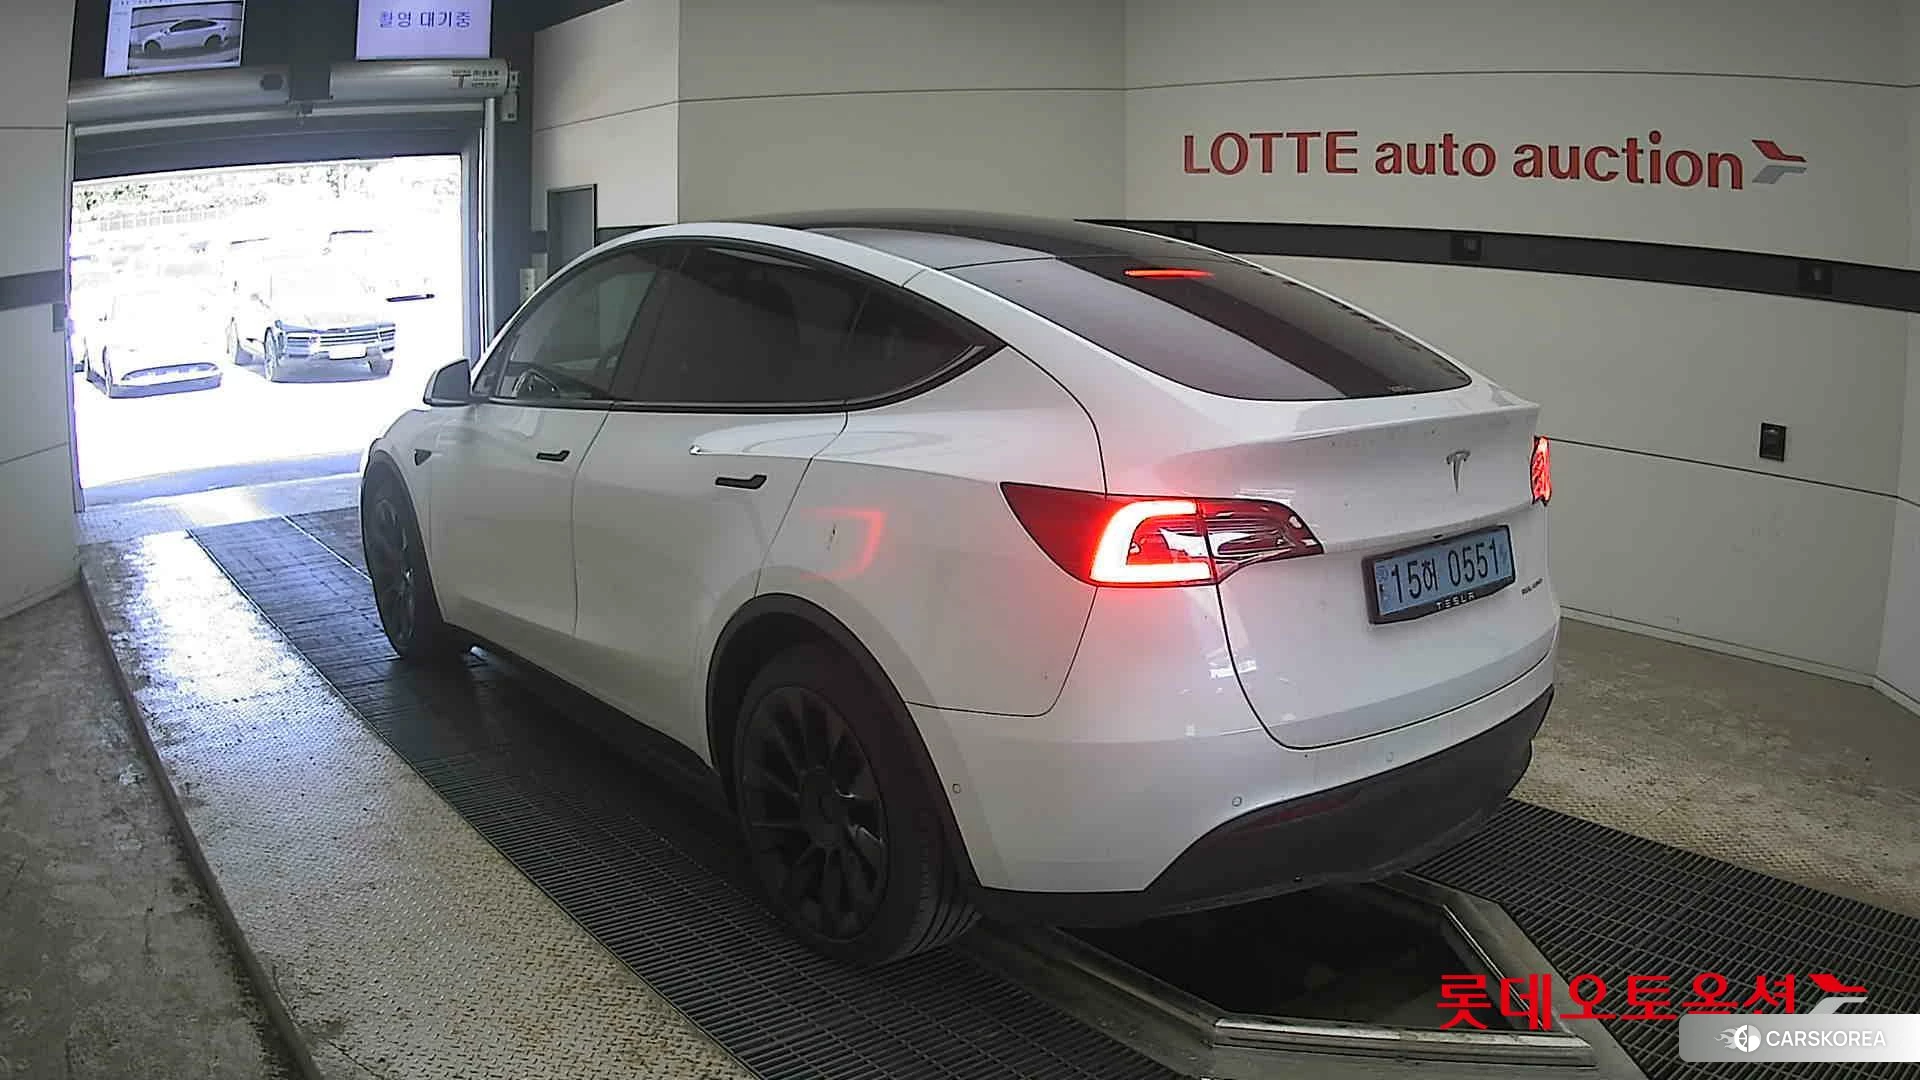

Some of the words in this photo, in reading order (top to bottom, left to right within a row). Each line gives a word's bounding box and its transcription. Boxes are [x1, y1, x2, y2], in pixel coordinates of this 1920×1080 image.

[420, 11, 470, 28] 대기중
[1183, 131, 1359, 175] LOTTE
[1374, 132, 1497, 177] auto
[1512, 130, 1744, 190] auction
[1448, 537, 1499, 587] 0551
[1436, 591, 1476, 610] TESLA
